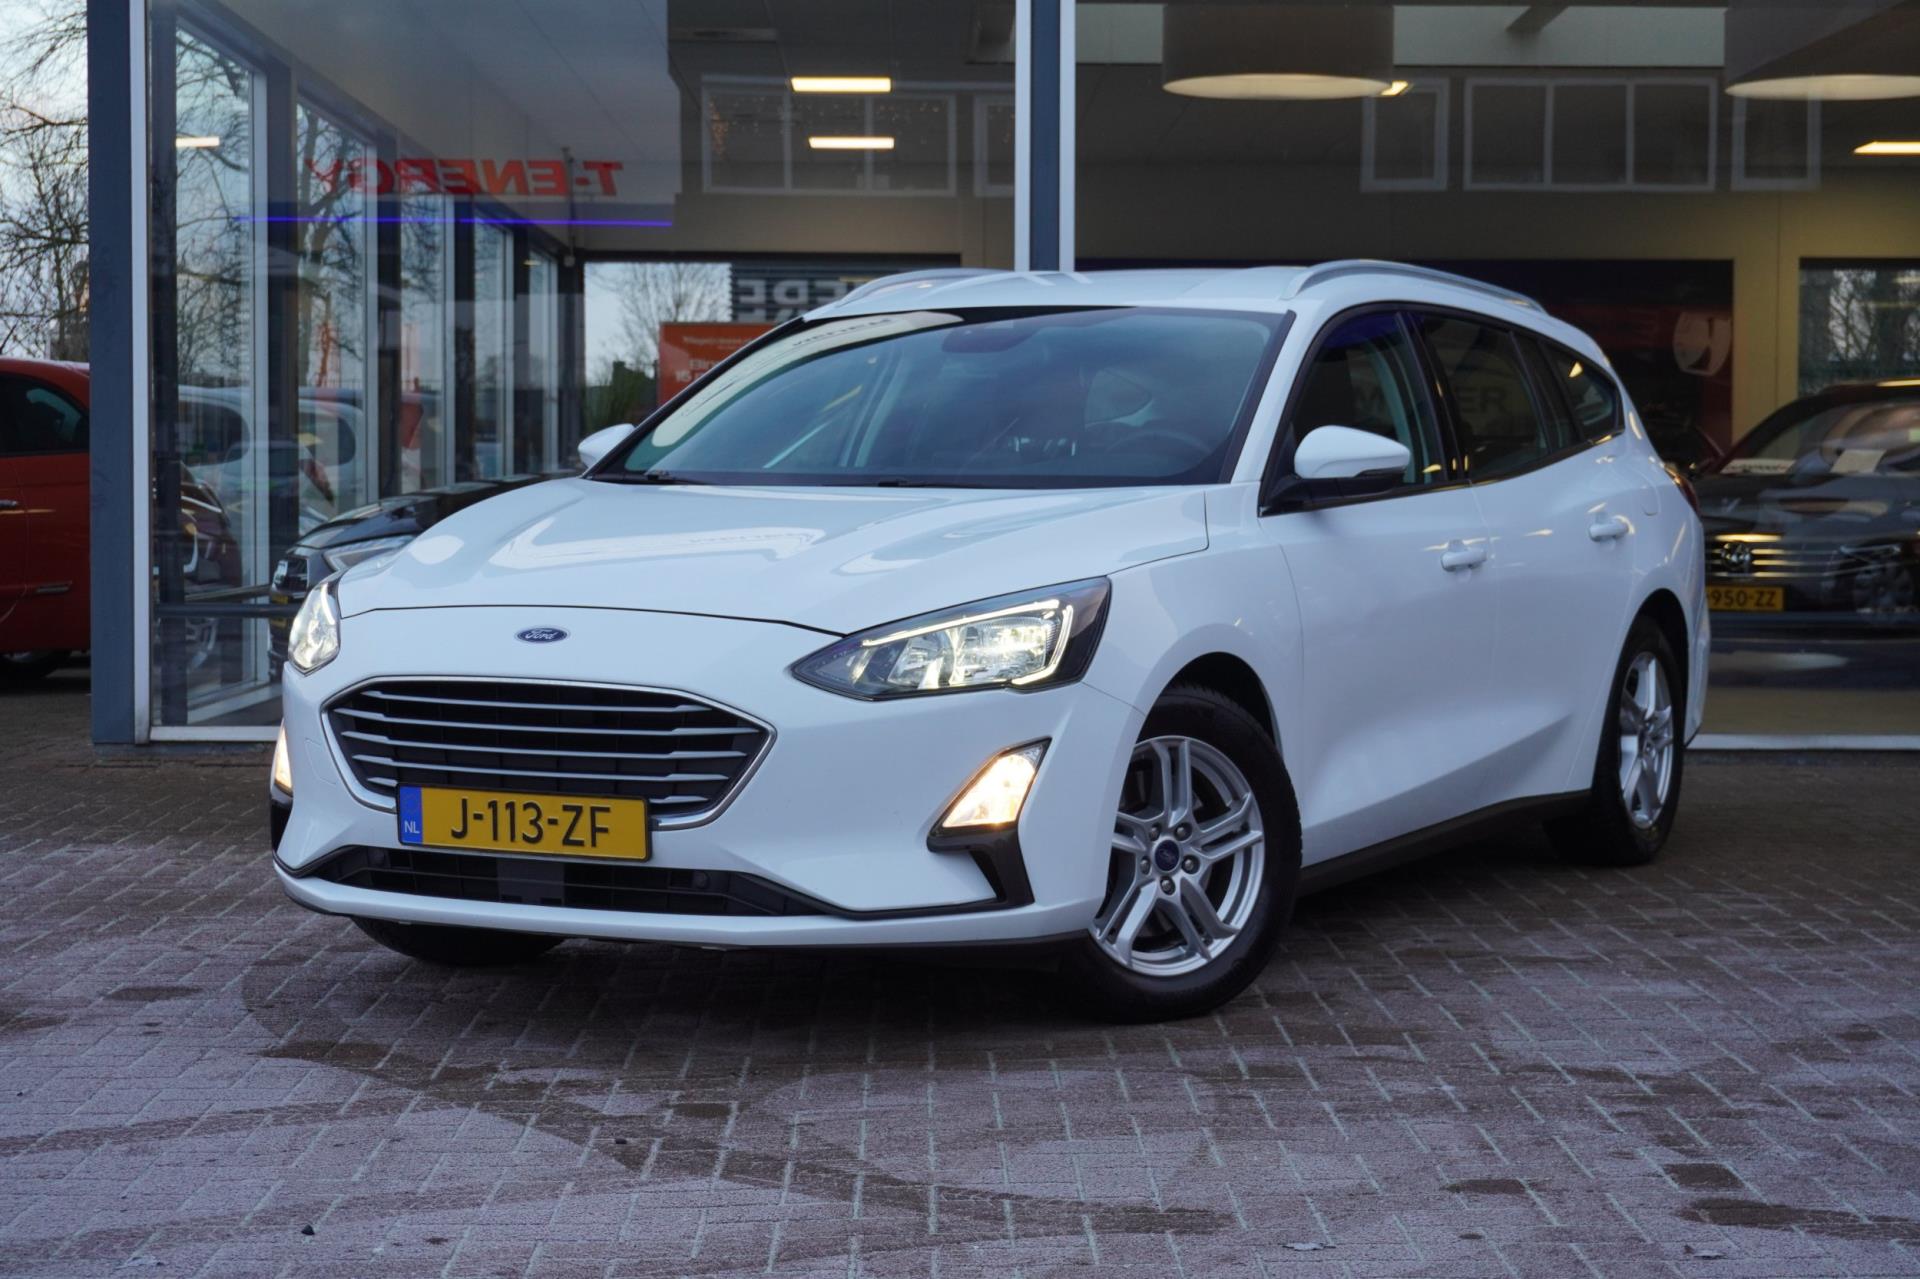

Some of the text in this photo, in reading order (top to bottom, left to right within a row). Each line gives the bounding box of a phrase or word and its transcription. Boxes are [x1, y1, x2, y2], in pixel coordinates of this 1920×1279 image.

[524, 629, 560, 640] Ford
[404, 820, 420, 834] NL
[451, 798, 611, 847] J-113-ZF
